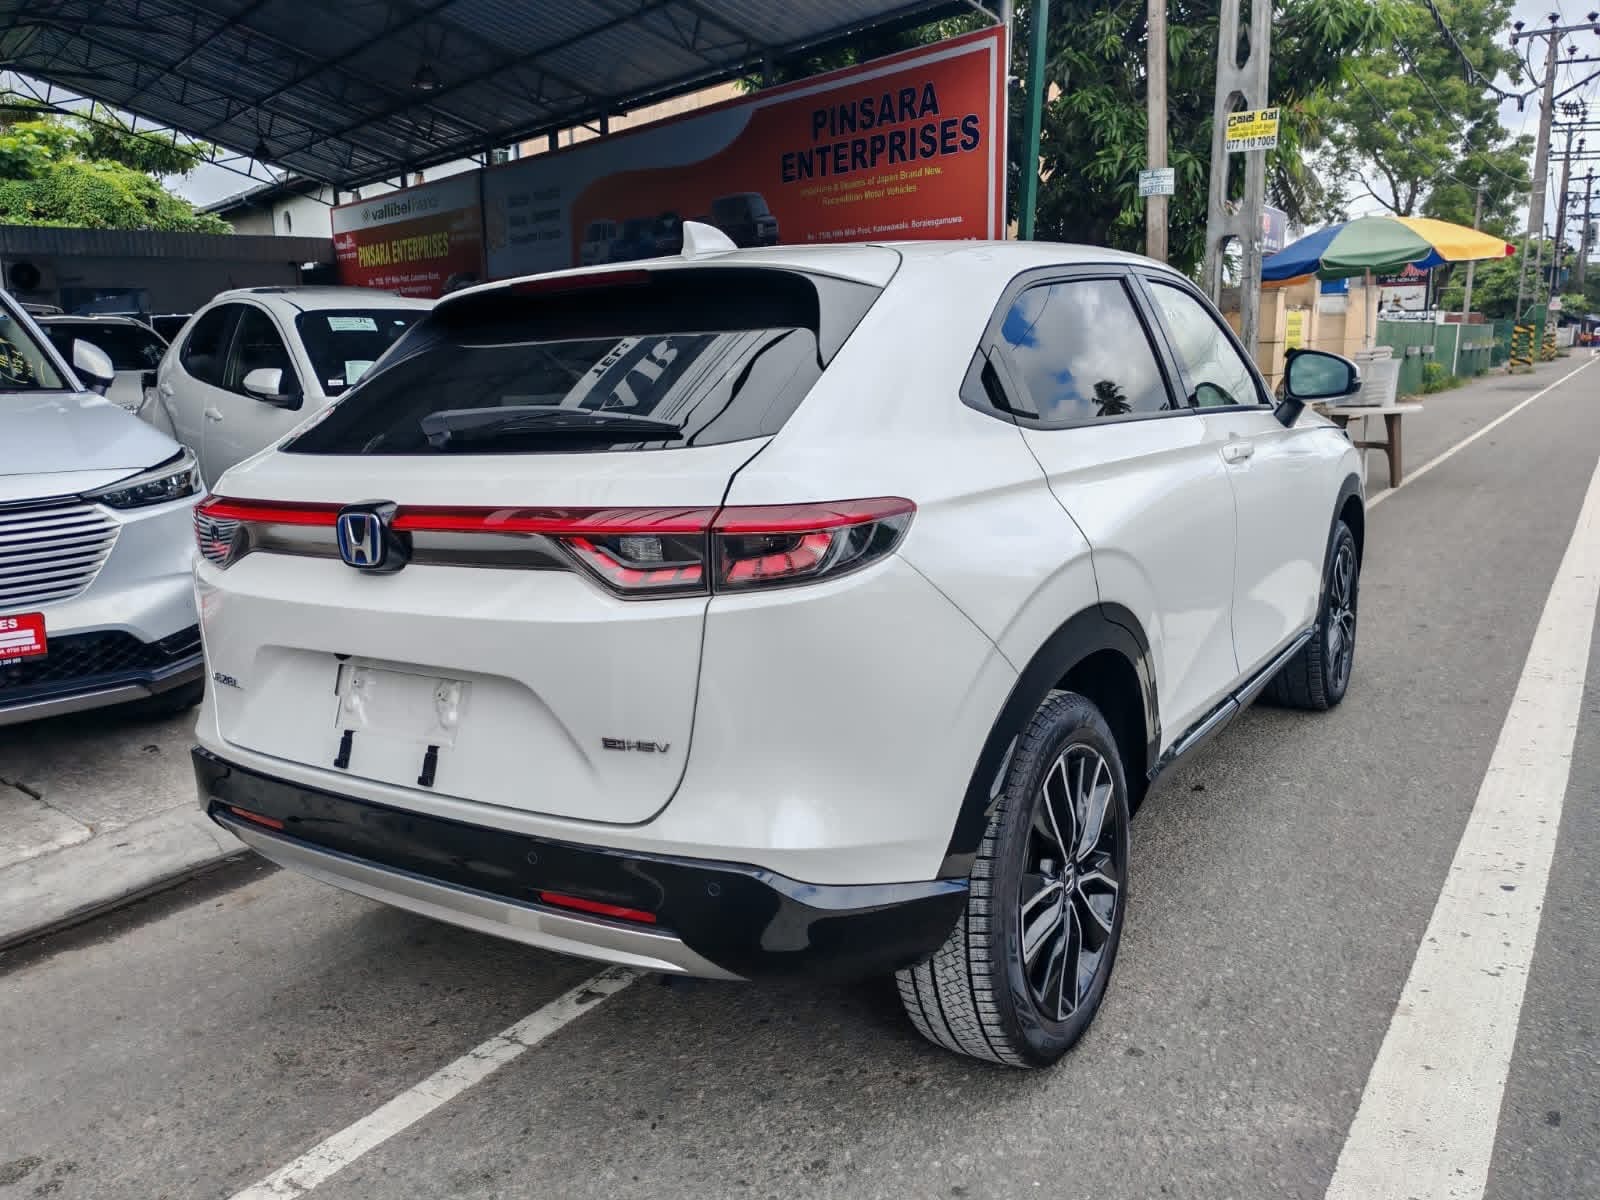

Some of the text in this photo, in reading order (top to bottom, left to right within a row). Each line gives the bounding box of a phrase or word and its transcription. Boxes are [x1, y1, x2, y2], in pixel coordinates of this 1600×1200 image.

[812, 82, 939, 141] PINSARA
[781, 114, 980, 183] ENTERPRISES
[1226, 139, 1240, 149] 077
[877, 172, 898, 185] Japan
[900, 167, 922, 180] Brand
[358, 232, 449, 267] PINSARA ENTERPRISES
